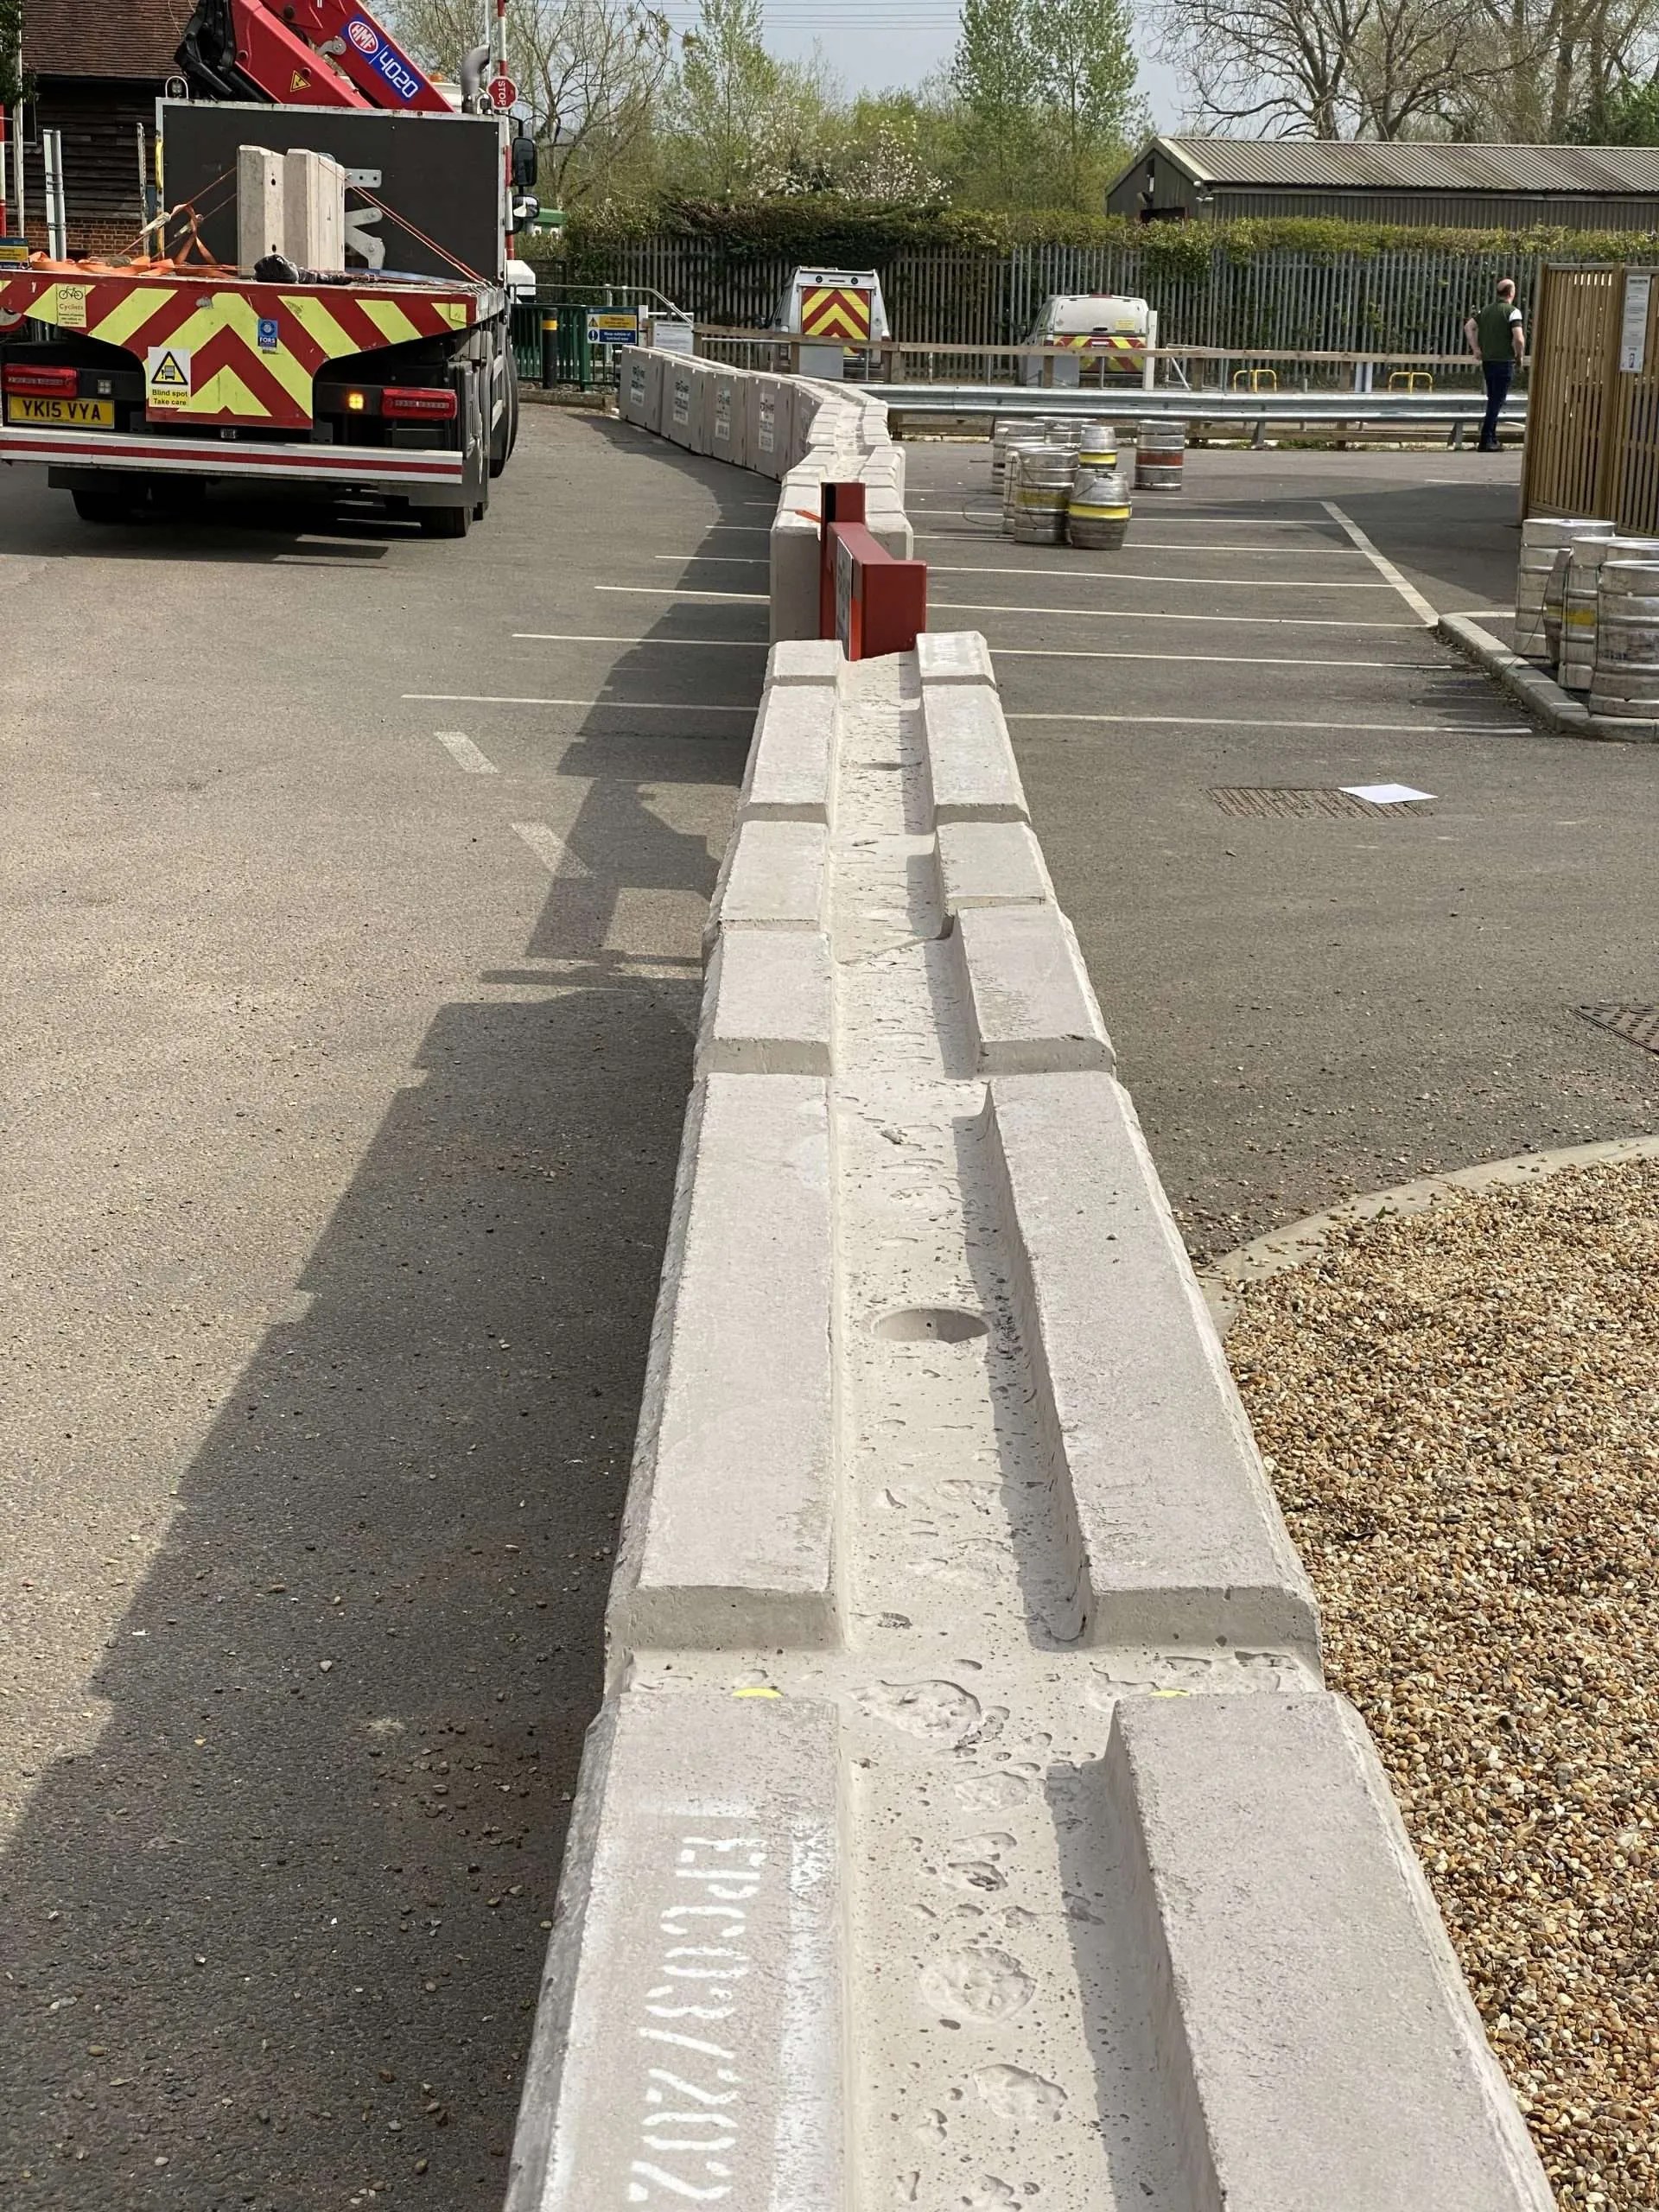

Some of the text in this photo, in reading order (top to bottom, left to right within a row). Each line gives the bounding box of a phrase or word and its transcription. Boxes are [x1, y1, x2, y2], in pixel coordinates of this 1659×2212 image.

[350, 23, 419, 98] HMF 4020
[498, 80, 506, 106] STOP
[22, 400, 101, 421] YK15 VYA
